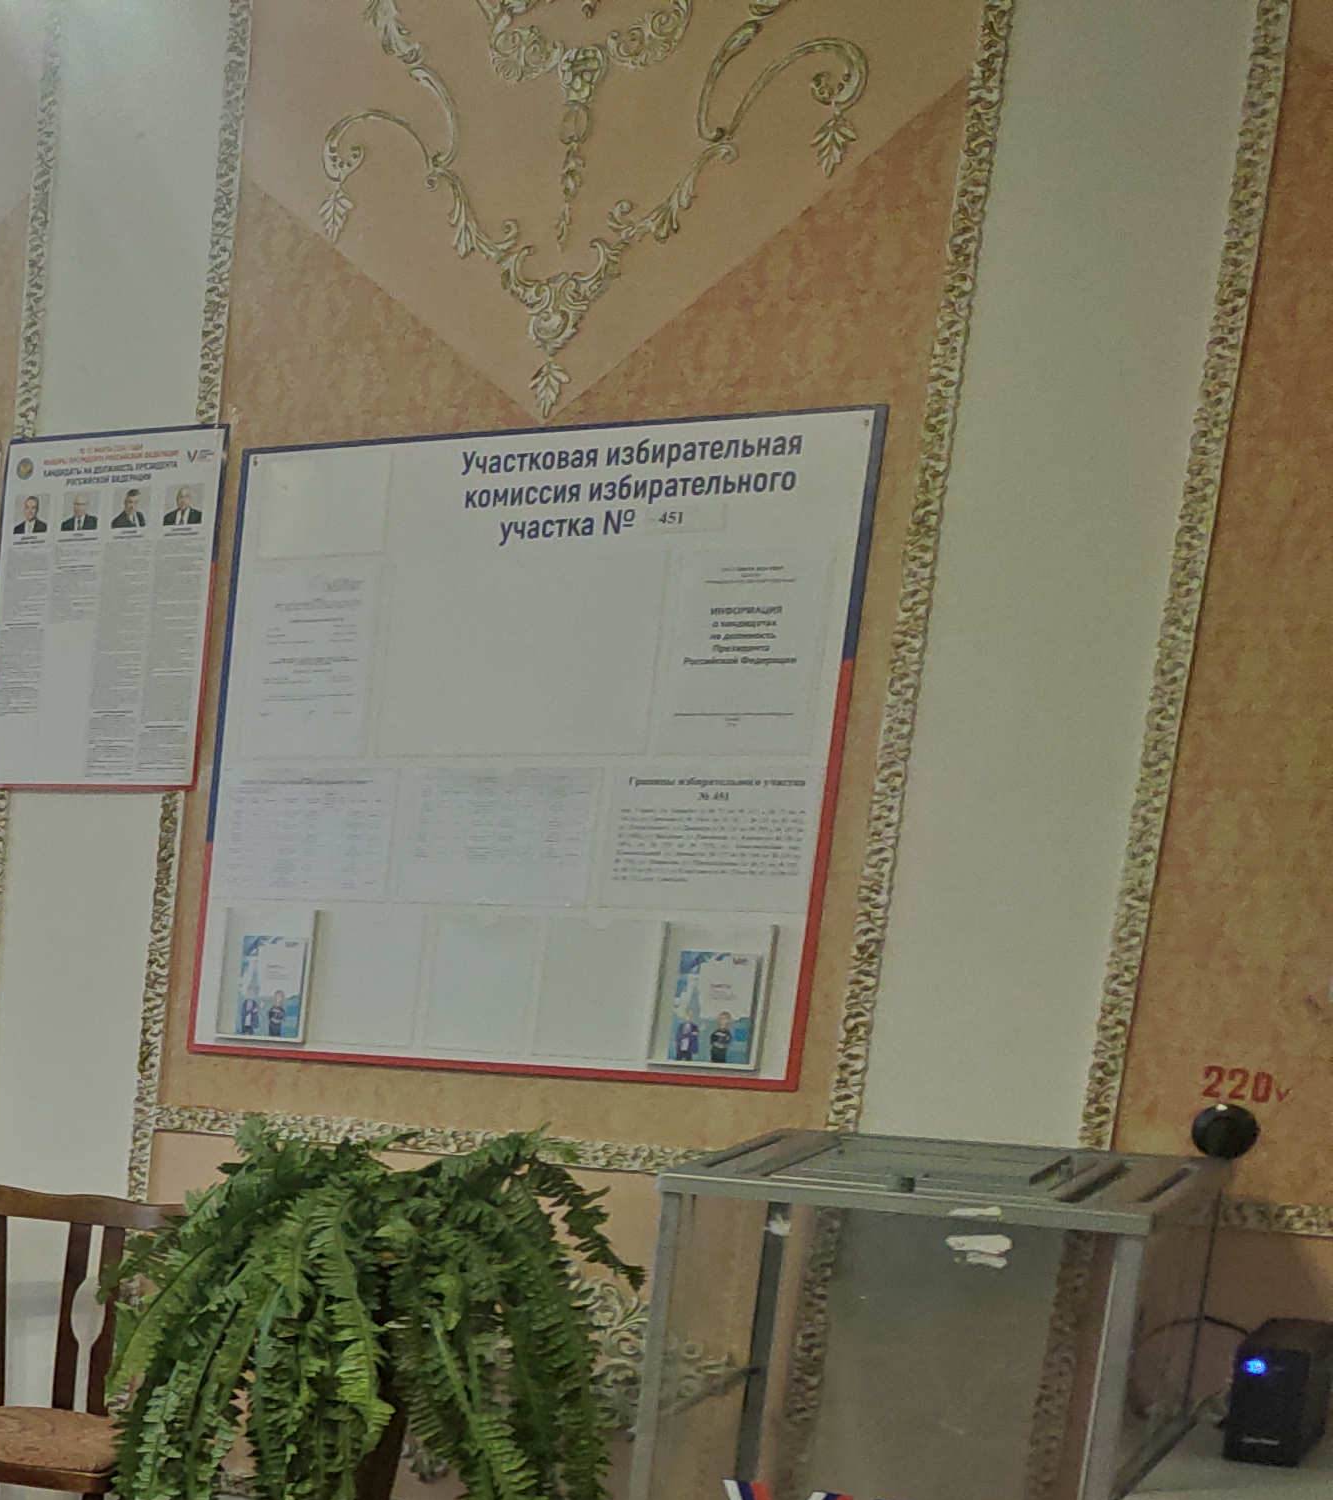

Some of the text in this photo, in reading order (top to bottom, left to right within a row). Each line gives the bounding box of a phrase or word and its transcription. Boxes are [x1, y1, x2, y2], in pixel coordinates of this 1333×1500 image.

[461, 435, 803, 475] Участковая избирательная
[465, 470, 797, 508] комиссия избирательного
[498, 516, 595, 546] участка
[603, 508, 636, 535] №
